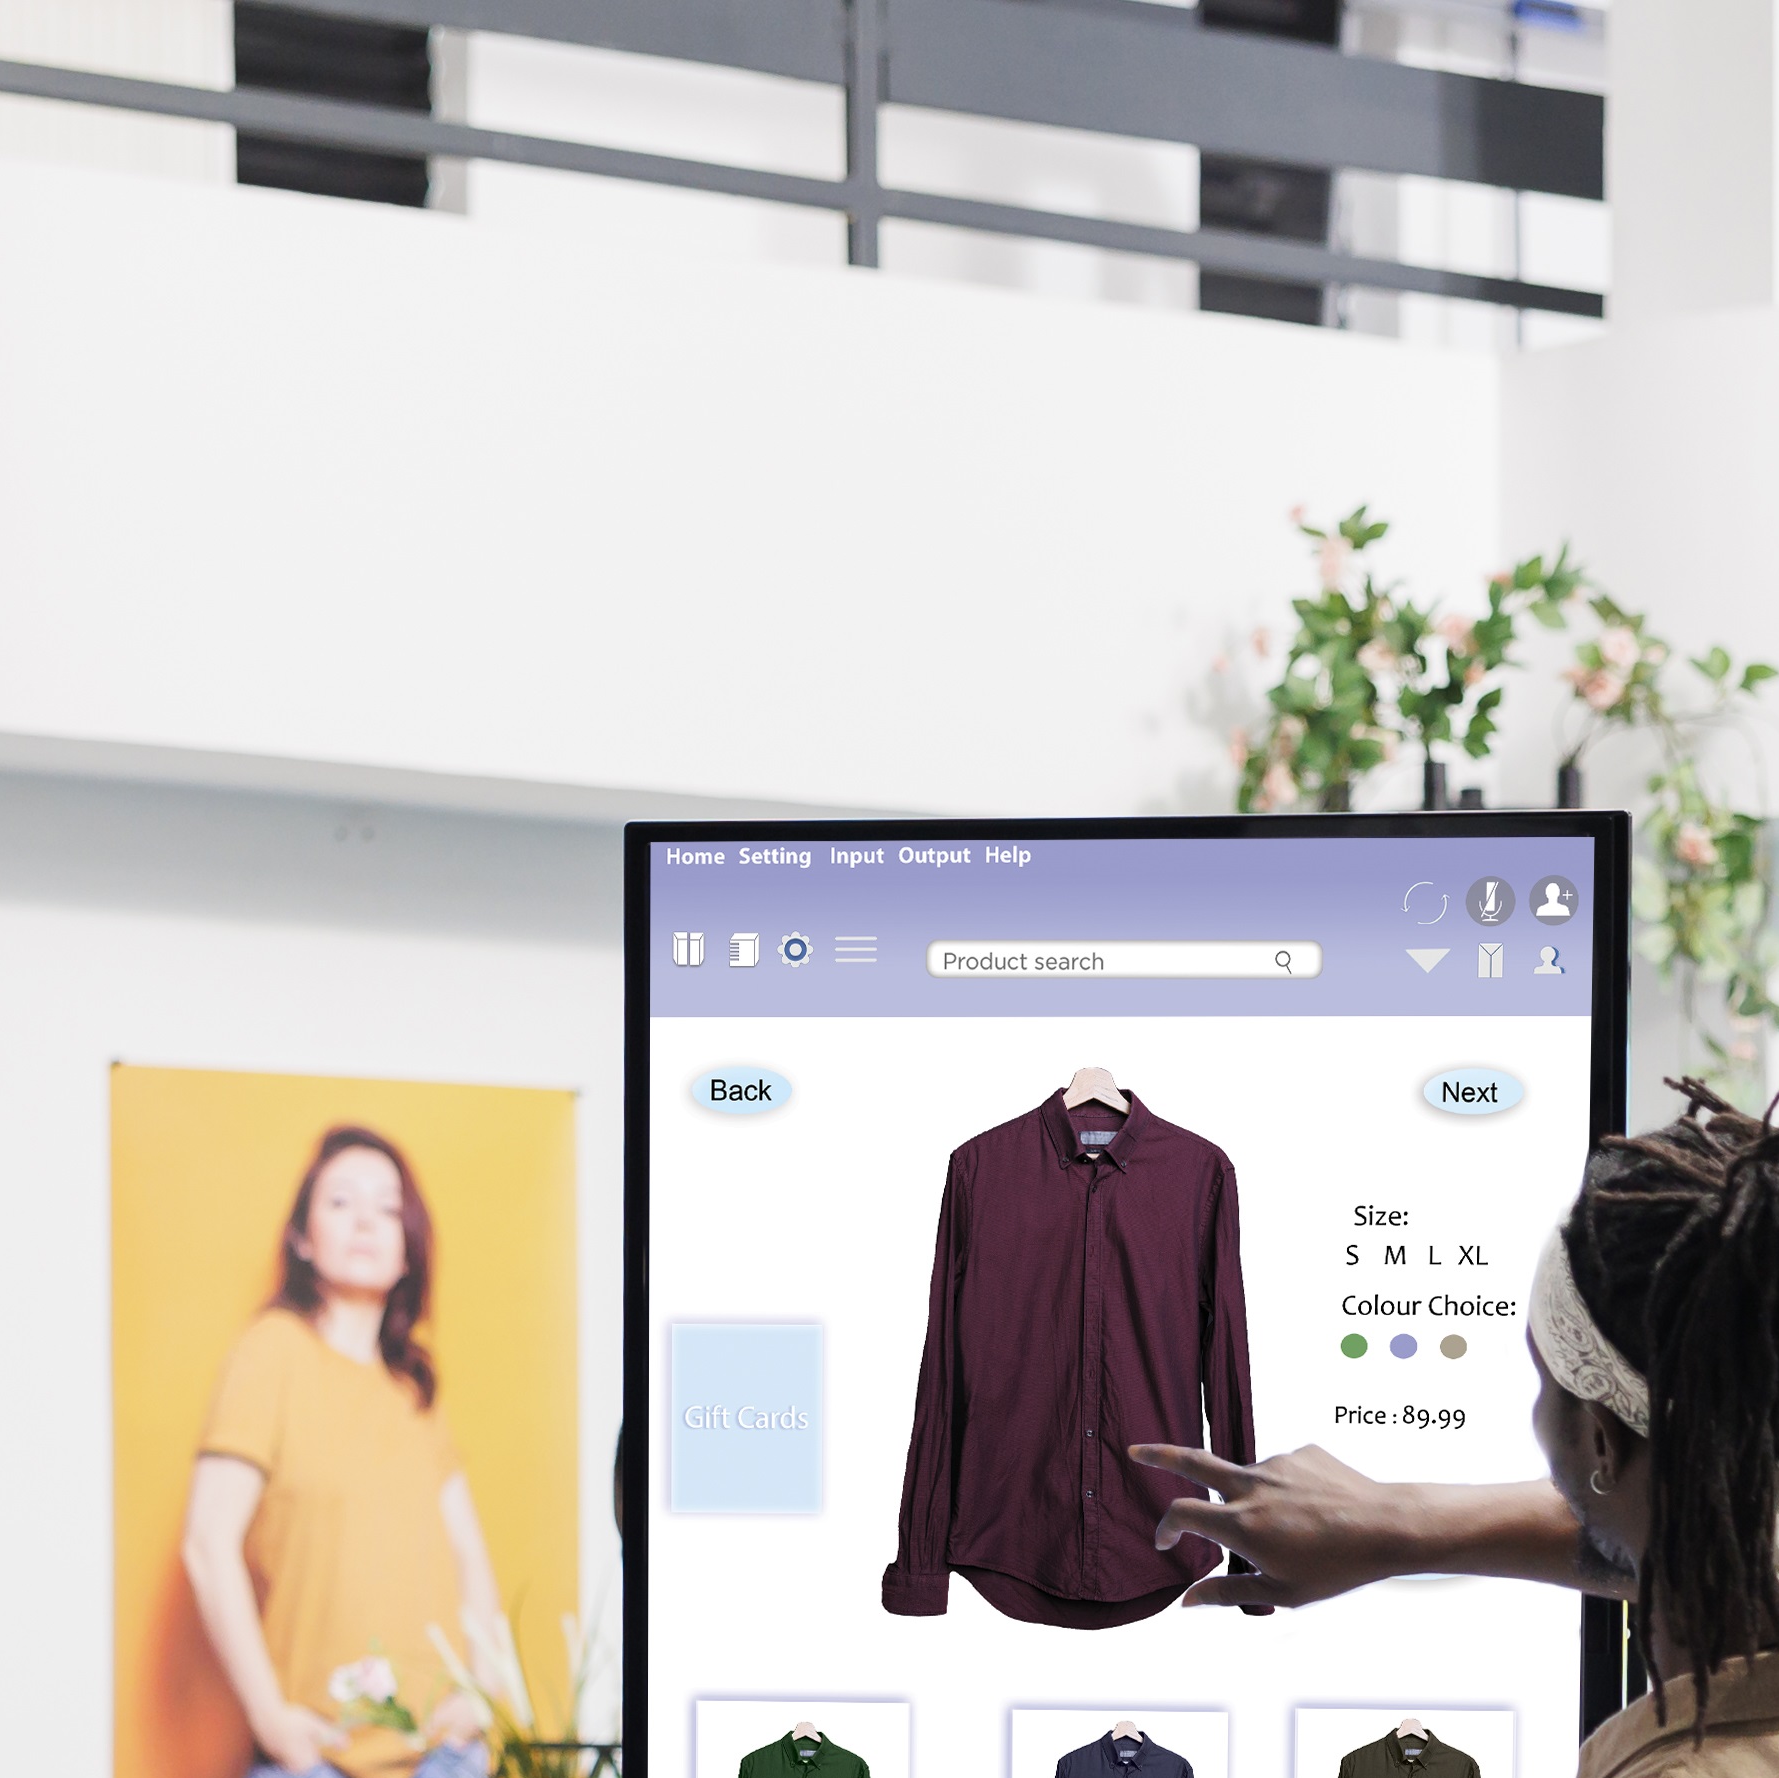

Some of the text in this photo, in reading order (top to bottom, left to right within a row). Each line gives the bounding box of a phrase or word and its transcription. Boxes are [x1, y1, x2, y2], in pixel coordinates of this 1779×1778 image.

[667, 846, 1031, 868] Home Setting Input Output Help
[942, 951, 1104, 971] Product search
[711, 1079, 771, 1101] Back
[1443, 1082, 1497, 1103] Next
[1354, 1205, 1408, 1226] Size:
[1346, 1245, 1488, 1265] S M L XL
[1342, 1294, 1515, 1316] Colour Choice:
[685, 1404, 809, 1429] Gift Cards
[1403, 1405, 1465, 1429] 89.99
